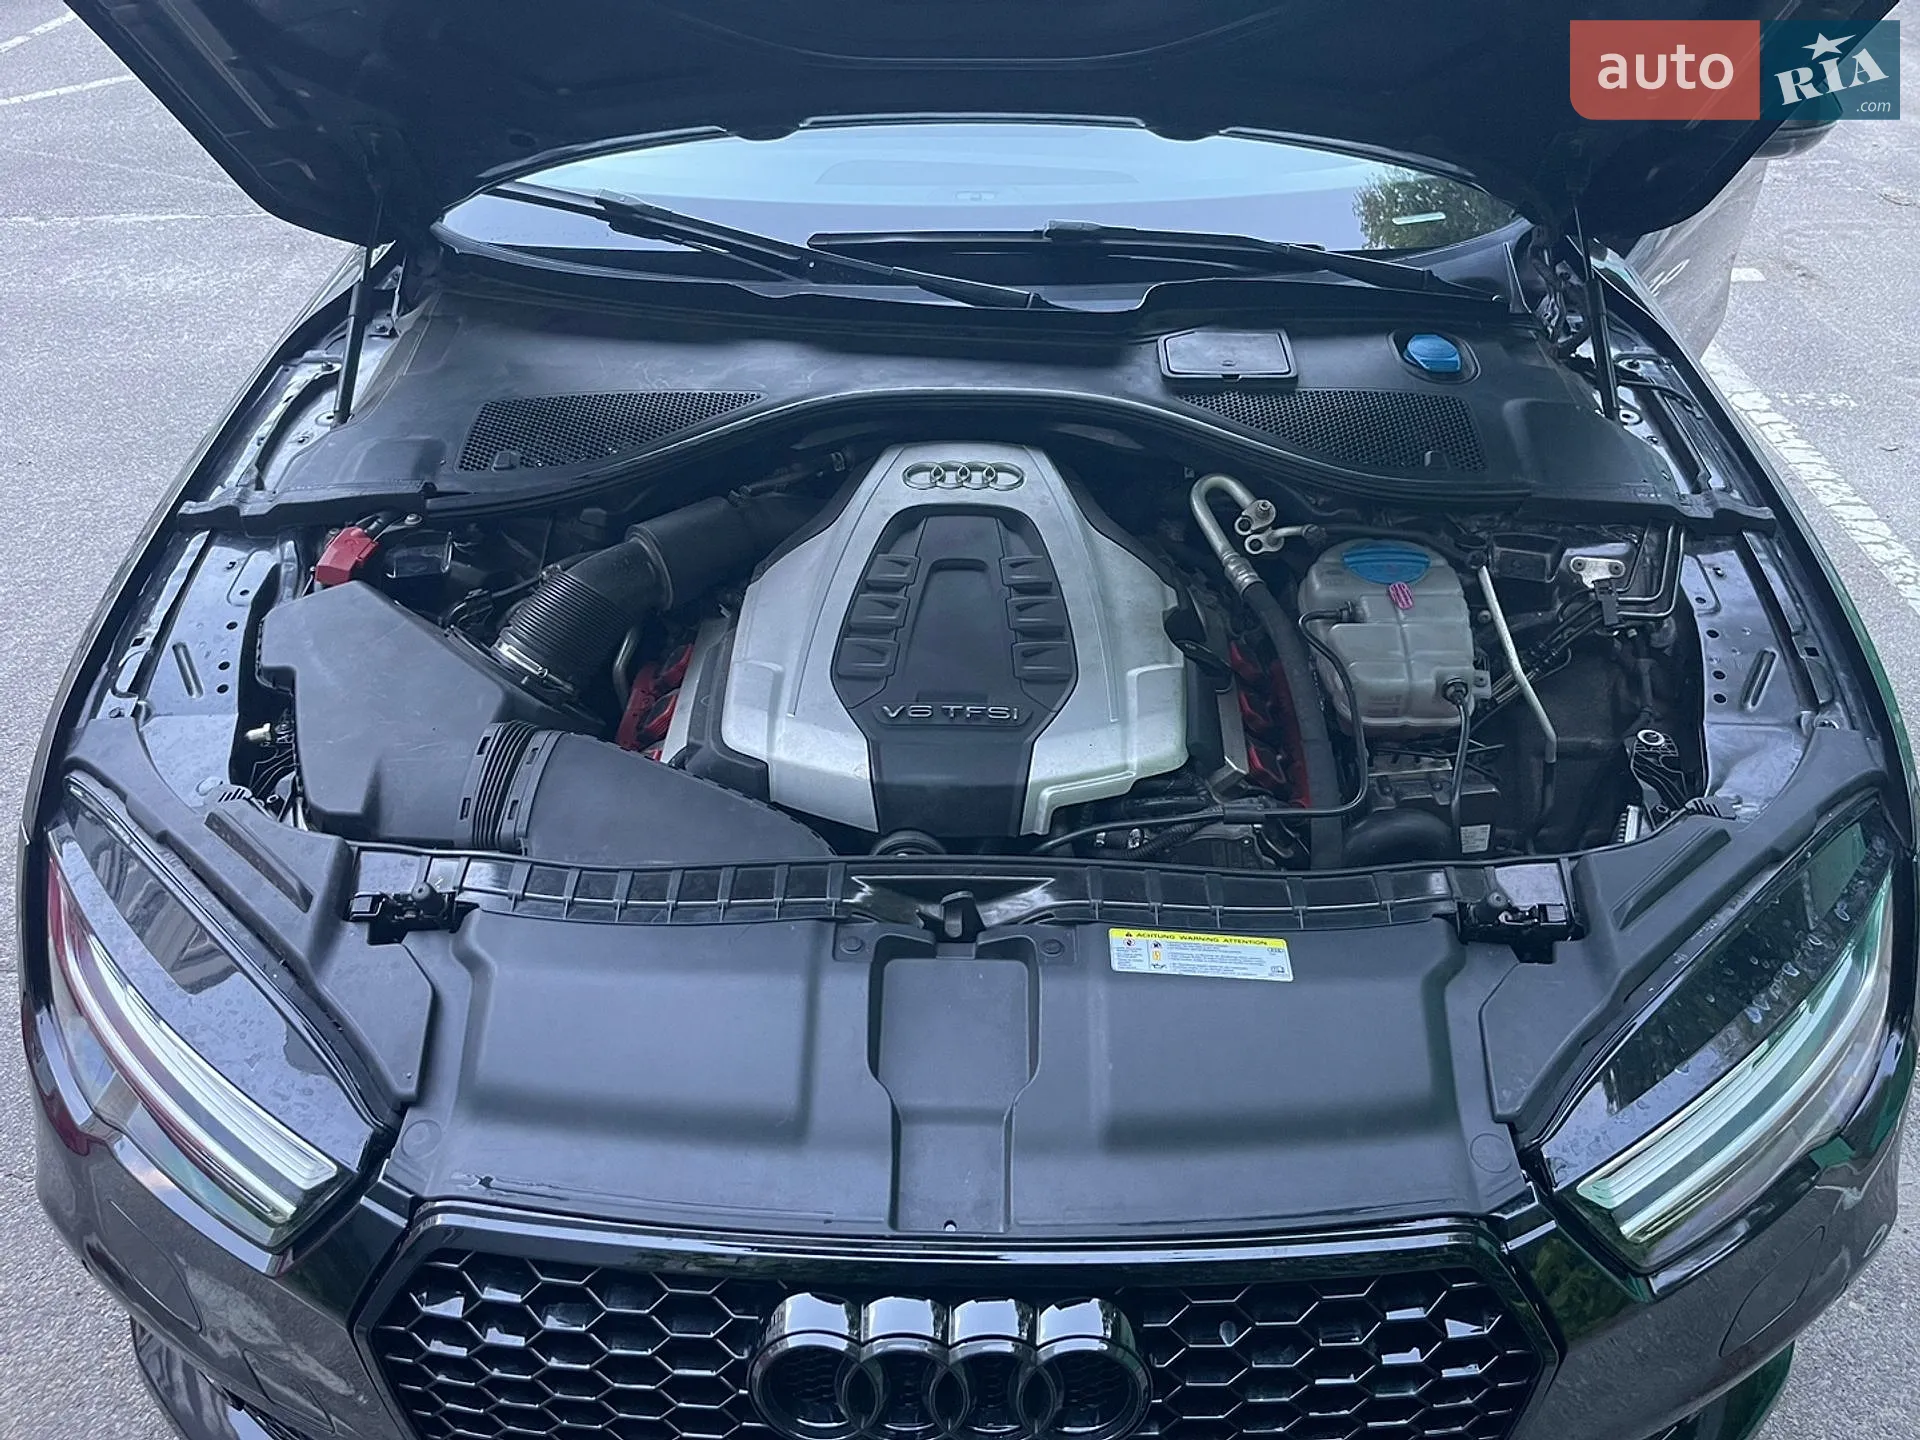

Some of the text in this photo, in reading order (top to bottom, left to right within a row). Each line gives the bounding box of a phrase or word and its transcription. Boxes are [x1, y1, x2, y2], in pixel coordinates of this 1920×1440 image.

[883, 705, 932, 718] V6
[1136, 932, 1268, 946] ACHTUNG WARNING ATTENTION
